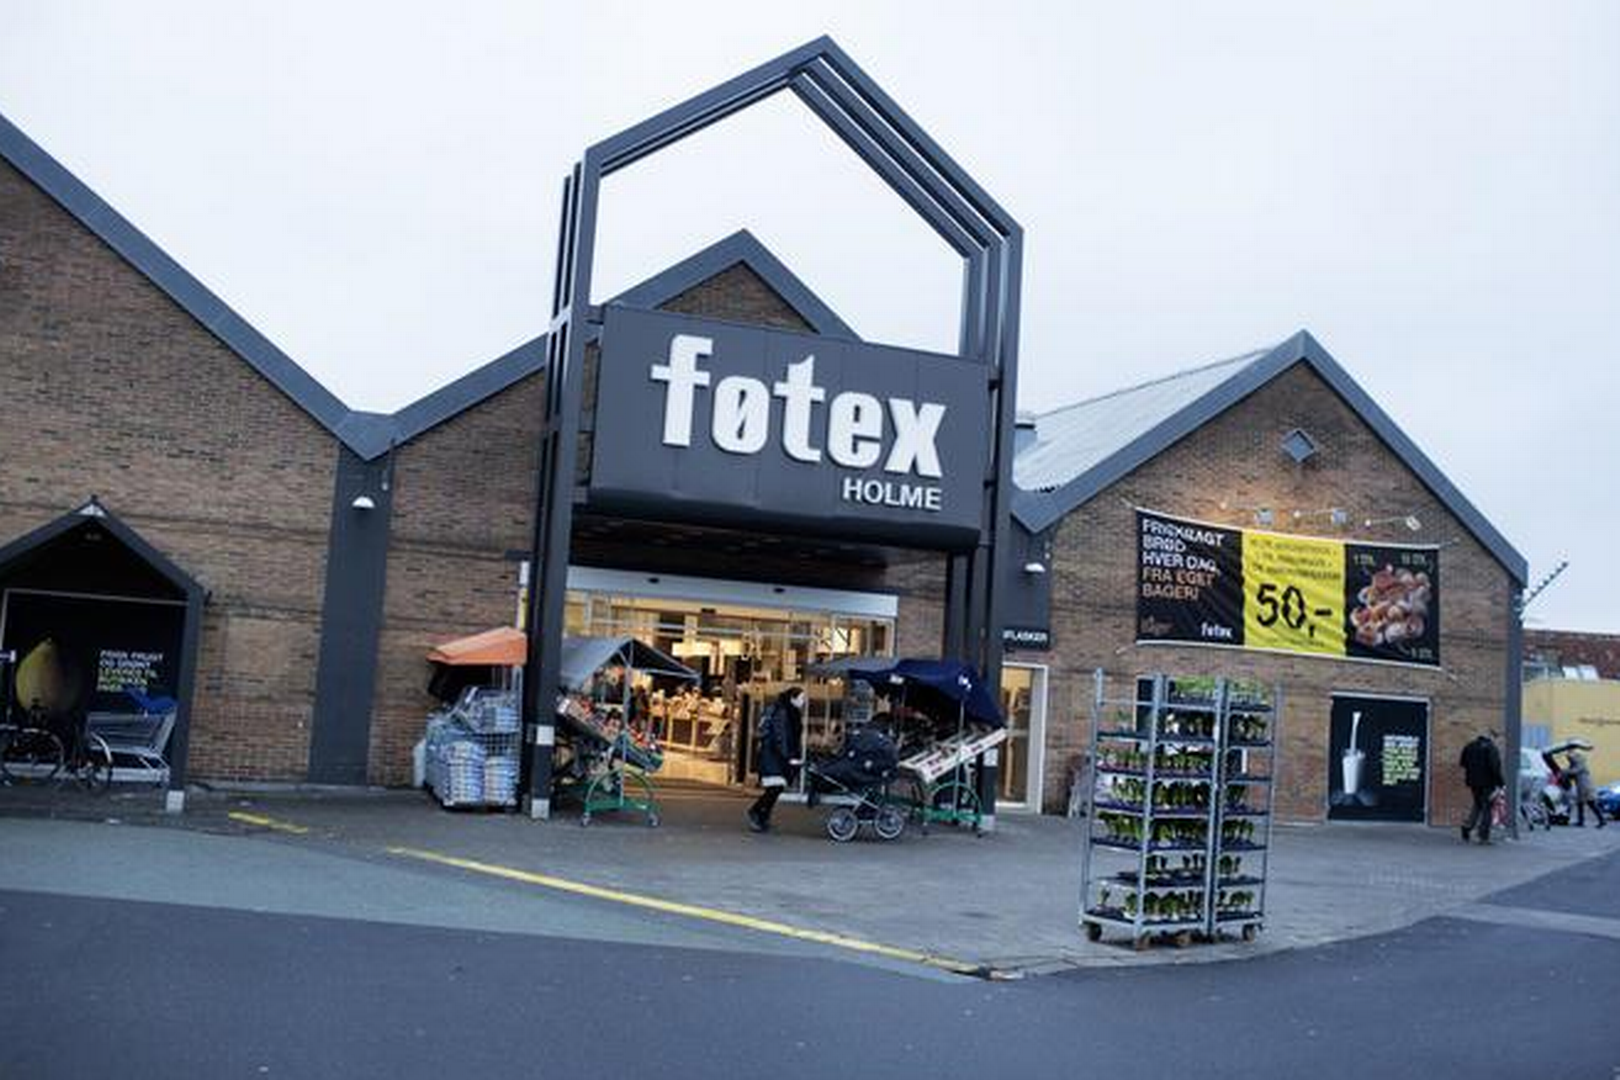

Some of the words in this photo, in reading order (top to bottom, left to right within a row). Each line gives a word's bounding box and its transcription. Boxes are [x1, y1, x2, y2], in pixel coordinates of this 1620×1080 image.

[651, 333, 947, 478] føtex
[843, 476, 942, 511] HOLME
[1142, 550, 1184, 568] HVER
[1142, 567, 1173, 582] FRA
